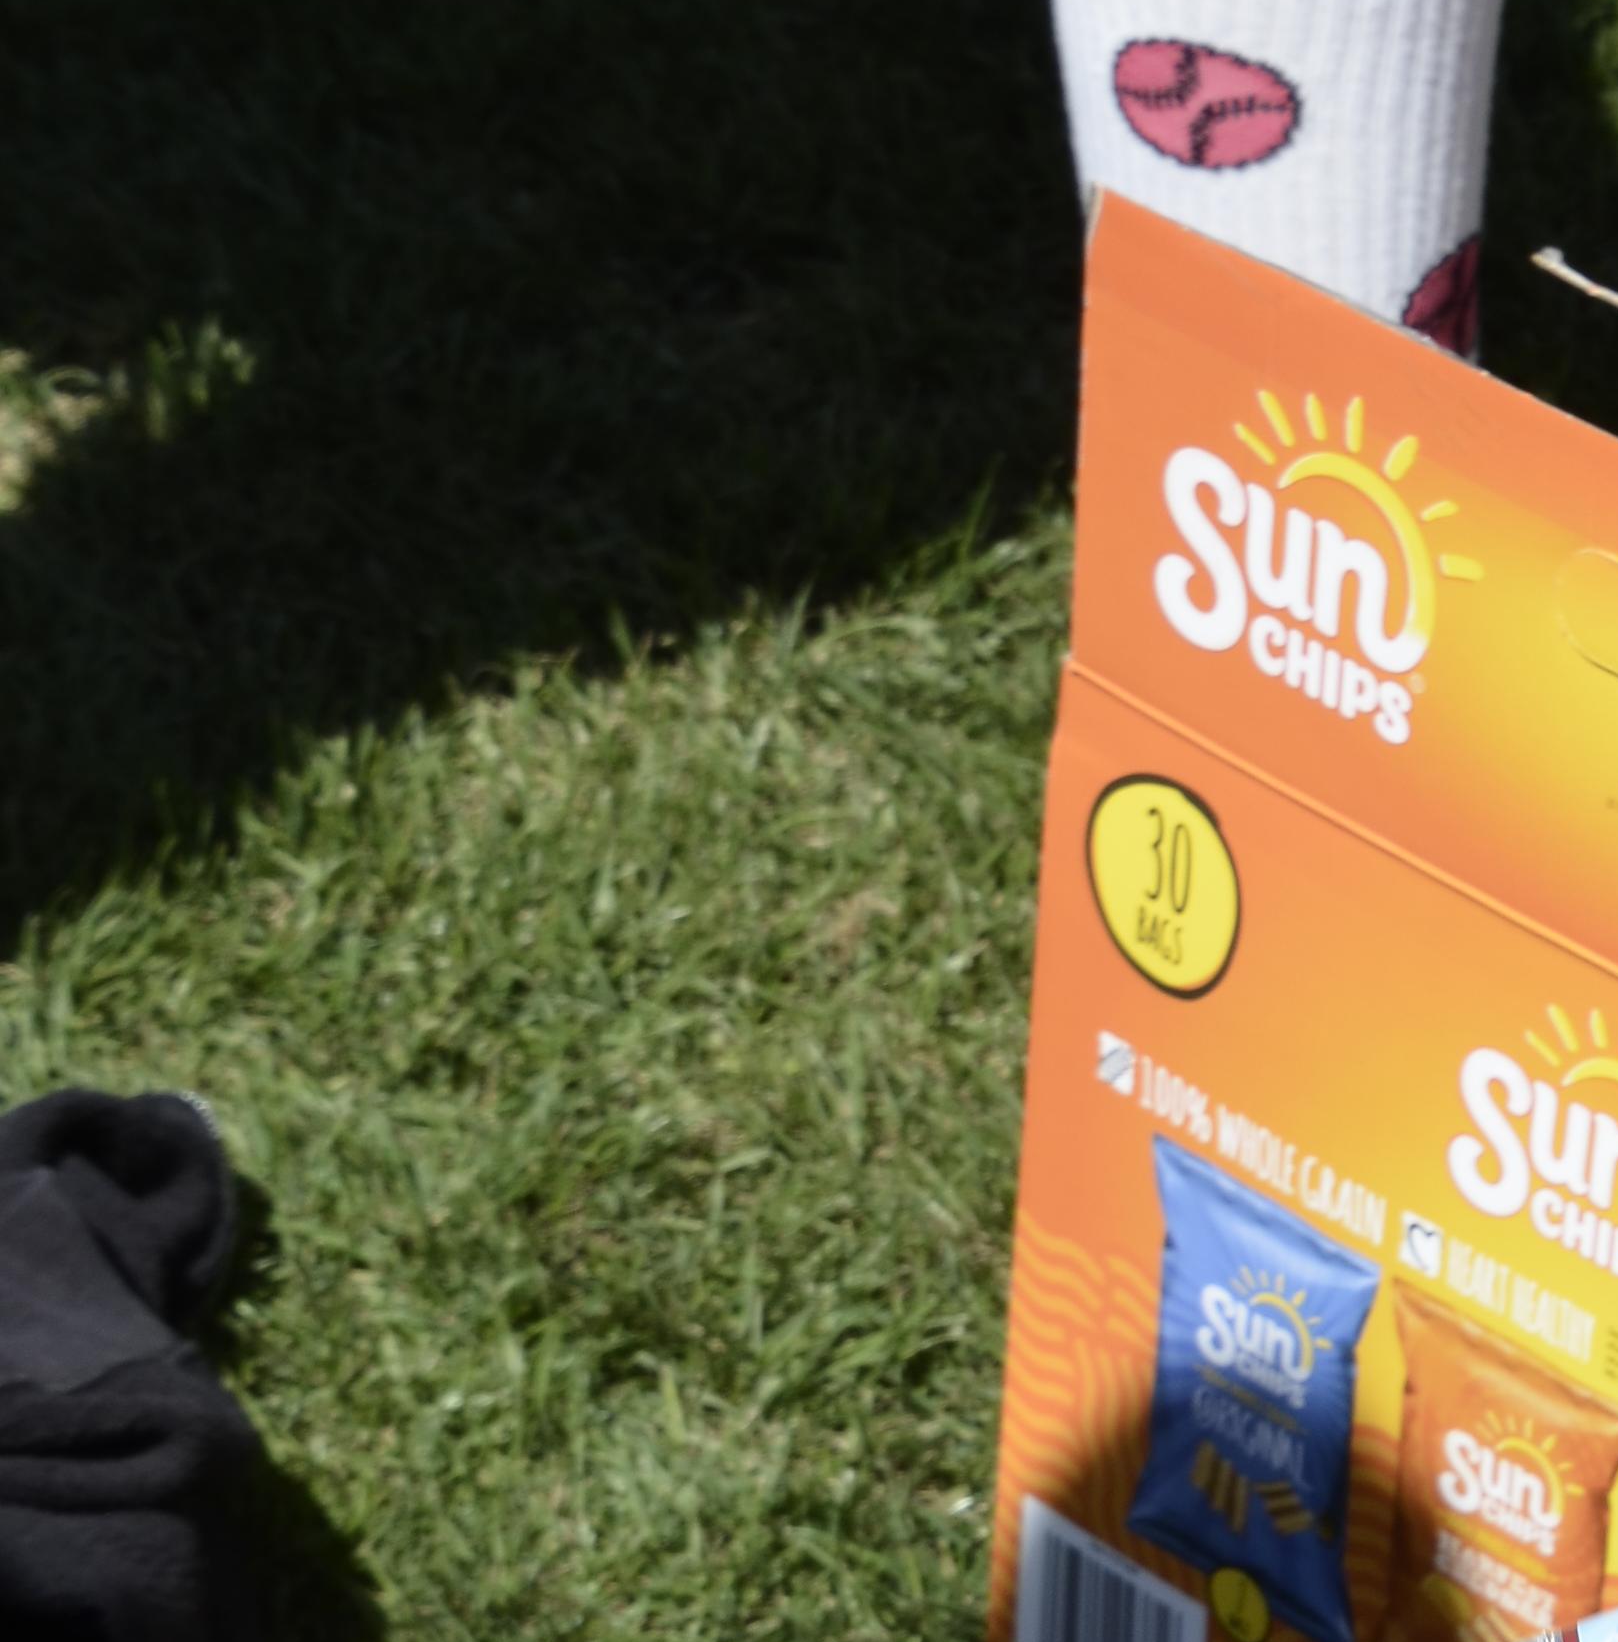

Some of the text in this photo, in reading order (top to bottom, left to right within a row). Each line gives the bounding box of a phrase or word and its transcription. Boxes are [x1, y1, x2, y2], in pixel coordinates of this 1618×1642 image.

[1154, 446, 1430, 673] Sun
[1248, 614, 1412, 744] CHIPS
[1144, 806, 1192, 914] 30
[1135, 905, 1184, 967] BAGS
[1139, 1055, 1388, 1248] 100% WHOLE GRAIN
[1197, 1284, 1312, 1381] Sun
[1436, 1429, 1562, 1526] Sun
